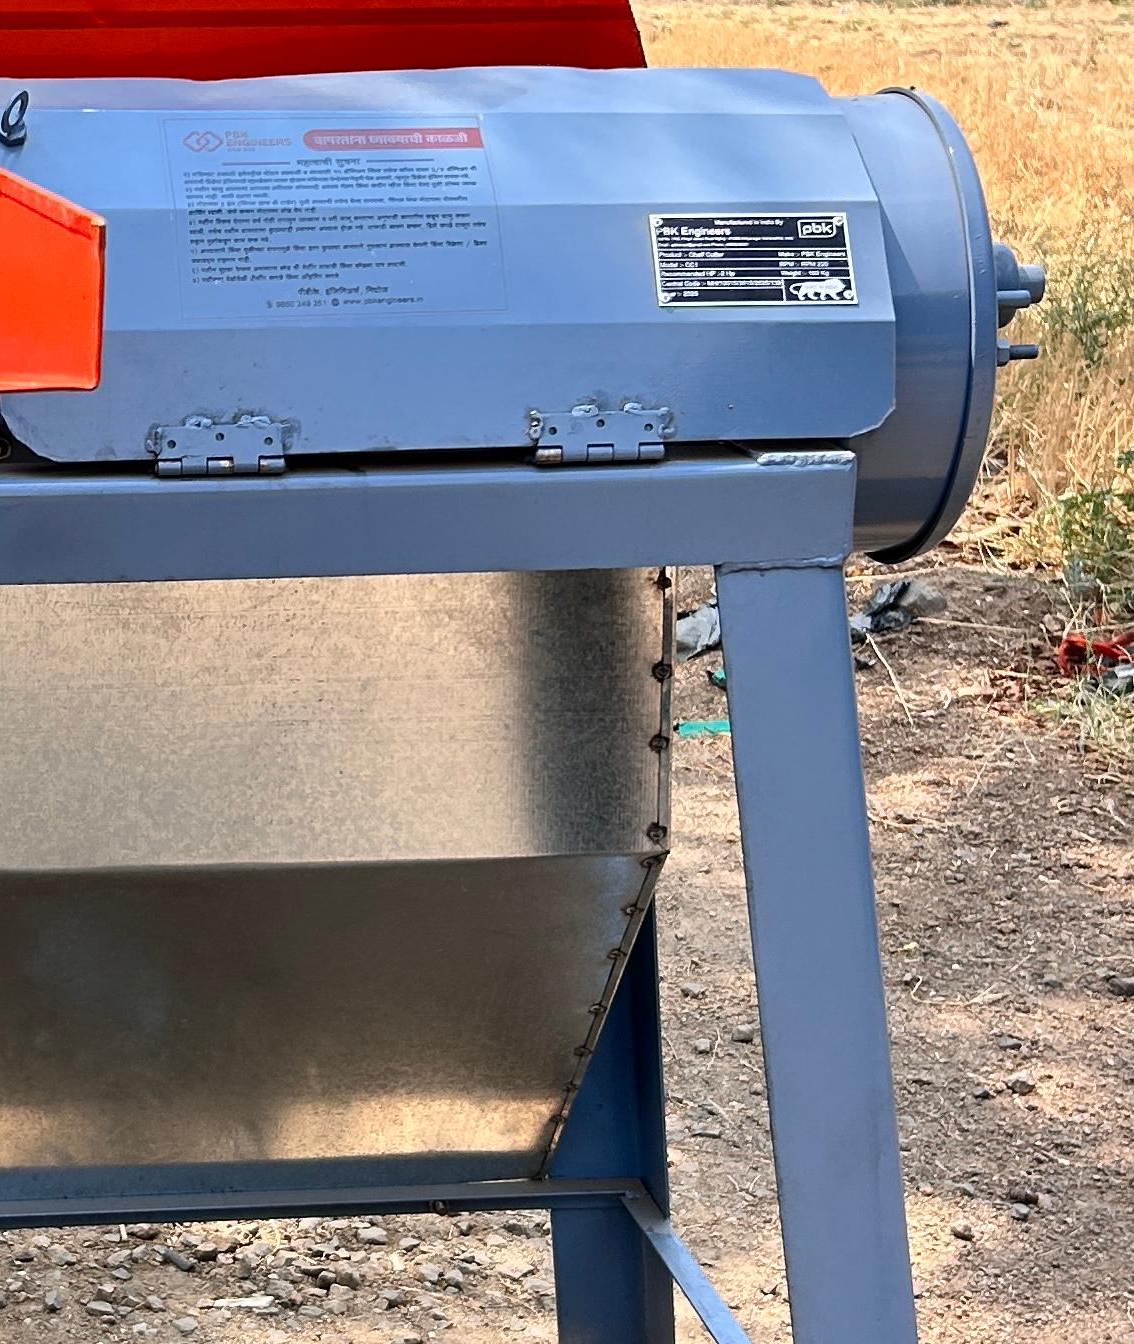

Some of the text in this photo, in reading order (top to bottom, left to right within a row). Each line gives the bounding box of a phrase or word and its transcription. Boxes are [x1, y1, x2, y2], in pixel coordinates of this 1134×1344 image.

[656, 227, 732, 237] PBK Engineers
[802, 223, 833, 235] pbk
